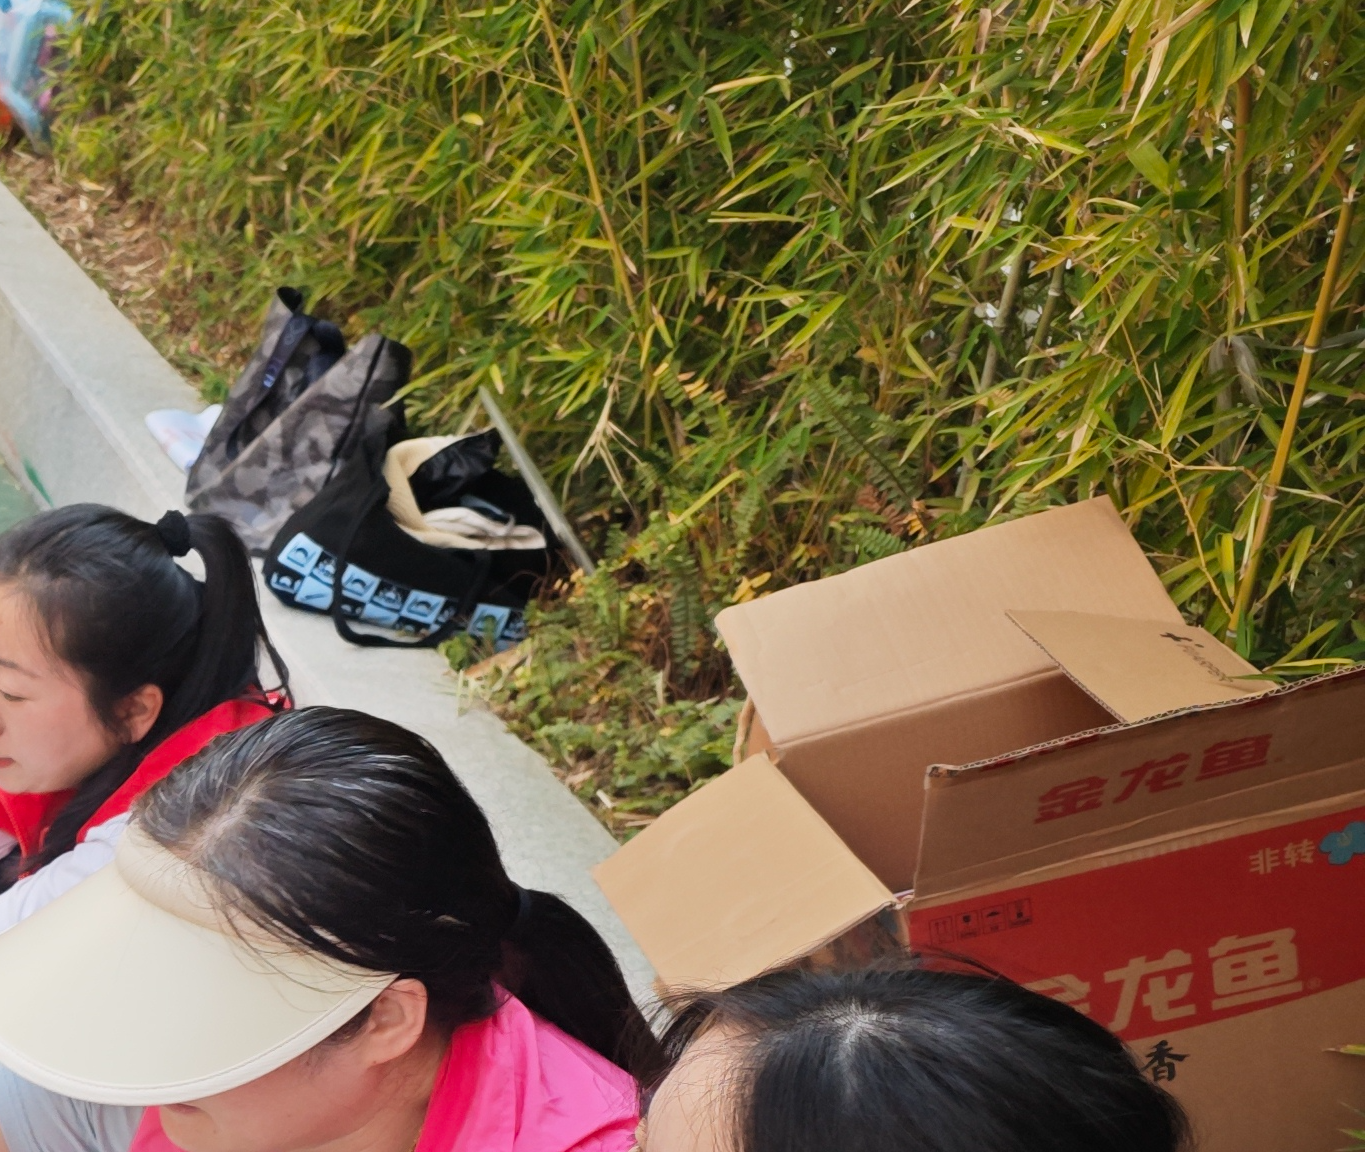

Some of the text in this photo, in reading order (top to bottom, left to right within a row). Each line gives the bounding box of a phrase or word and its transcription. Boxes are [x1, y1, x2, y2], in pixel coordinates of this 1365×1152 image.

[1034, 733, 1273, 825] 金龙鱼
[1139, 1039, 1191, 1082] 香
